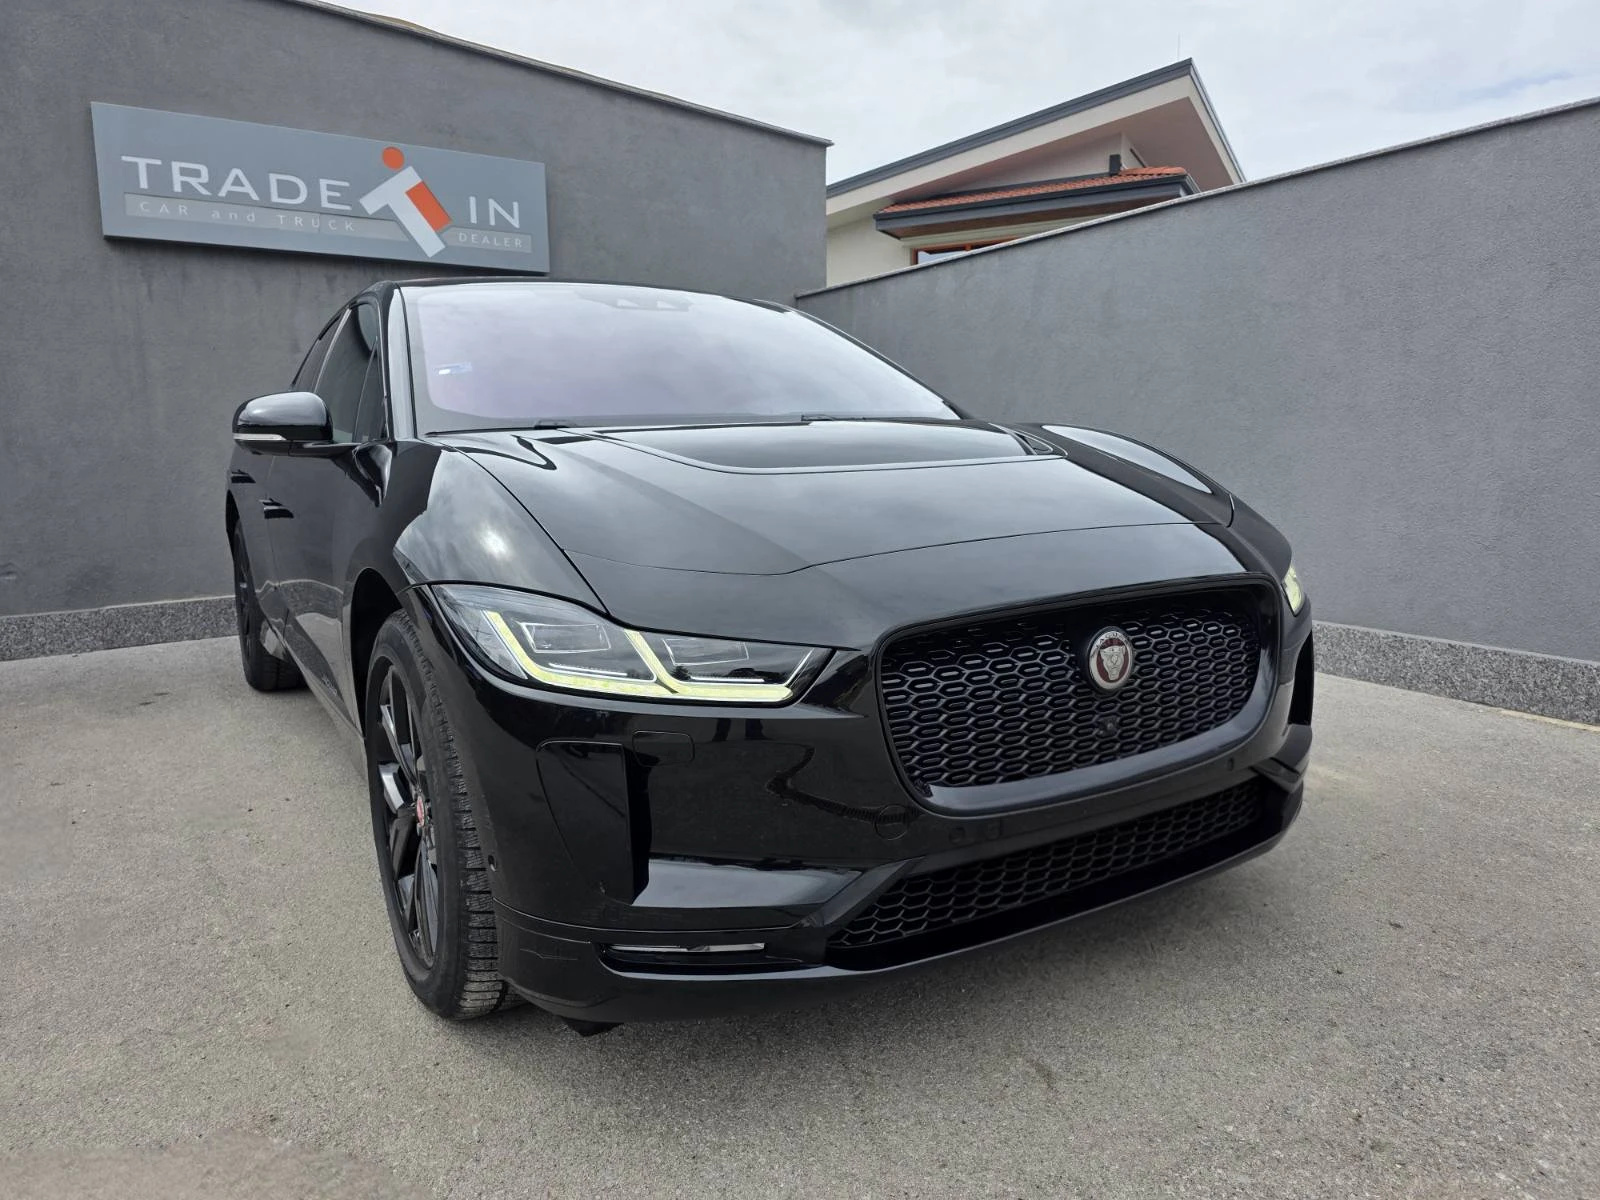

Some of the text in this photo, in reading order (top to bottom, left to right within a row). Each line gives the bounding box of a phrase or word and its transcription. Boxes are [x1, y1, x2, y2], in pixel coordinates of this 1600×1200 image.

[121, 155, 352, 210] TRADE
[469, 196, 520, 229] IN
[140, 202, 523, 248] CAR and TRUCK DEALER
